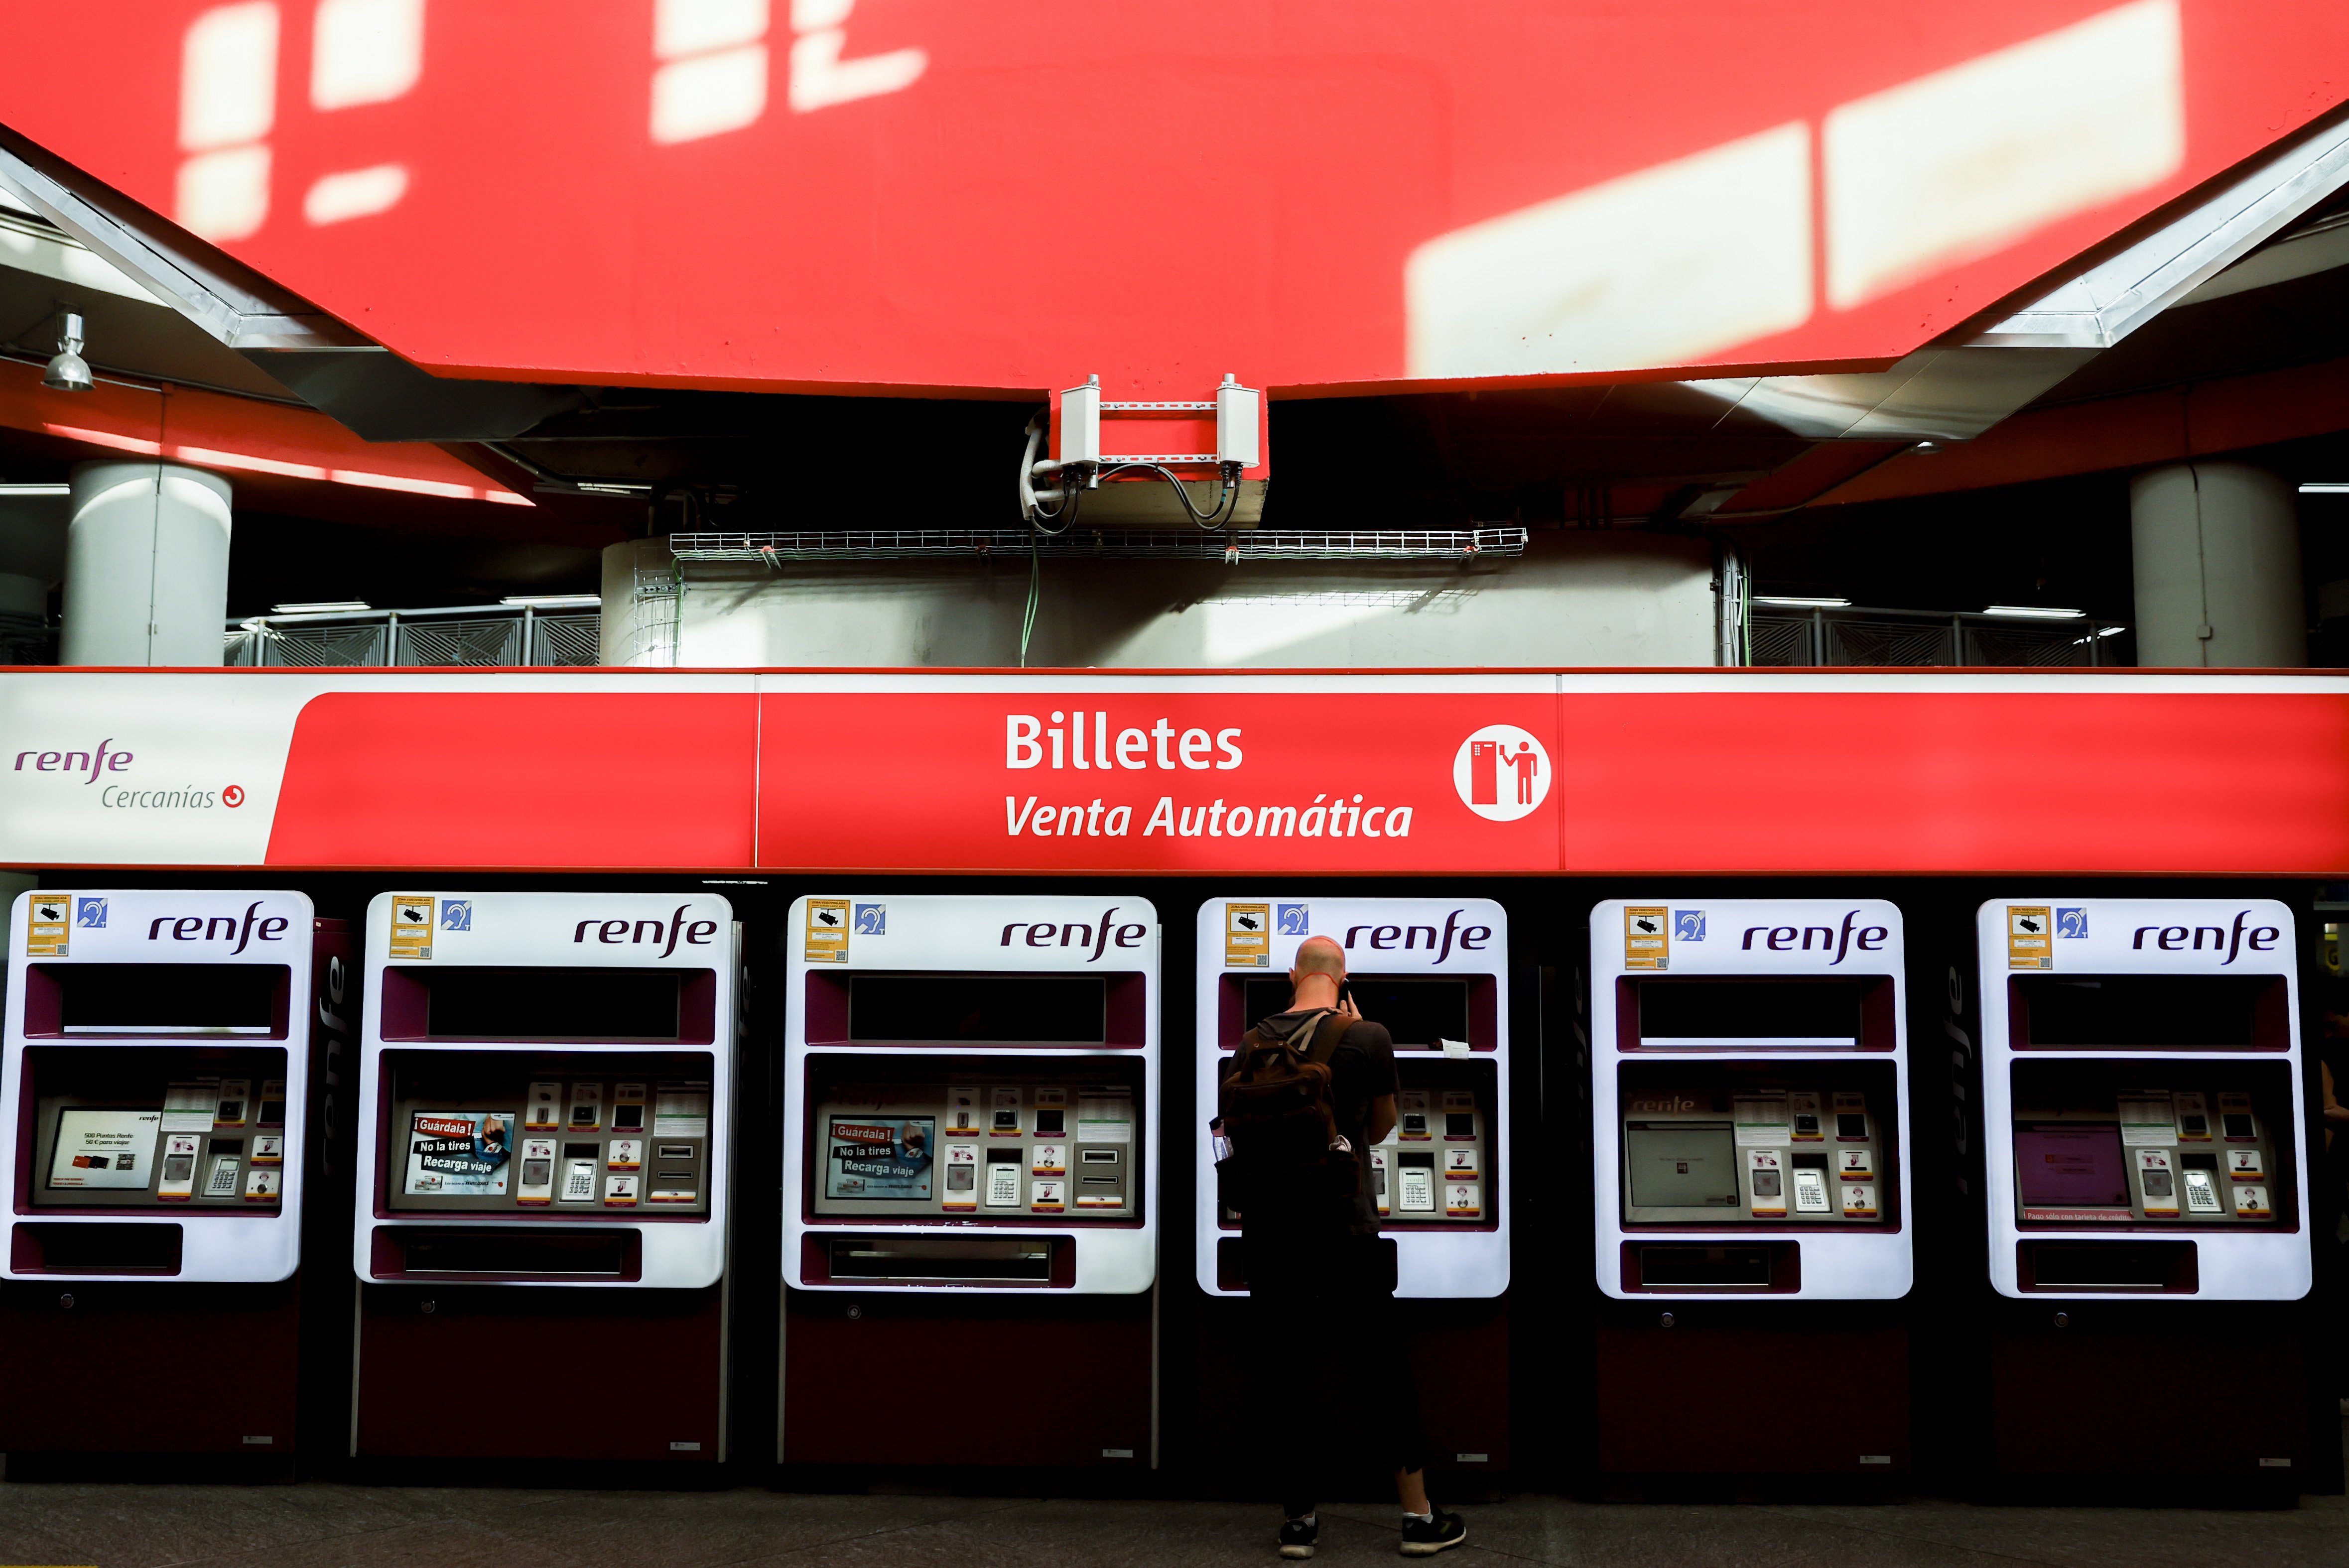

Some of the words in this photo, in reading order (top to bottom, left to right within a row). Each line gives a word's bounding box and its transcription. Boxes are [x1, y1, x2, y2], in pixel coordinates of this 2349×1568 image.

[14, 738, 134, 785] renfe
[1005, 711, 1243, 770] Billetes
[102, 785, 215, 809] Cercanías
[1005, 796, 1133, 837] Venta
[1143, 794, 1414, 837] Automática
[148, 901, 288, 956] renfe
[573, 904, 717, 959] renfe
[1000, 907, 1147, 963] renfe
[1344, 909, 1491, 965] renfe
[1741, 909, 1888, 966] renfe
[2132, 909, 2280, 965] renfe
[420, 1142, 434, 1152] No
[436, 1142, 445, 1151] la
[448, 1141, 471, 1151] tires
[423, 1155, 468, 1172] Recarga
[471, 1162, 492, 1173] viaje
[840, 1147, 853, 1156] No
[856, 1147, 865, 1156] la
[868, 1146, 891, 1155] tires
[844, 1160, 890, 1175] Recarga
[892, 1166, 914, 1177] viaje
